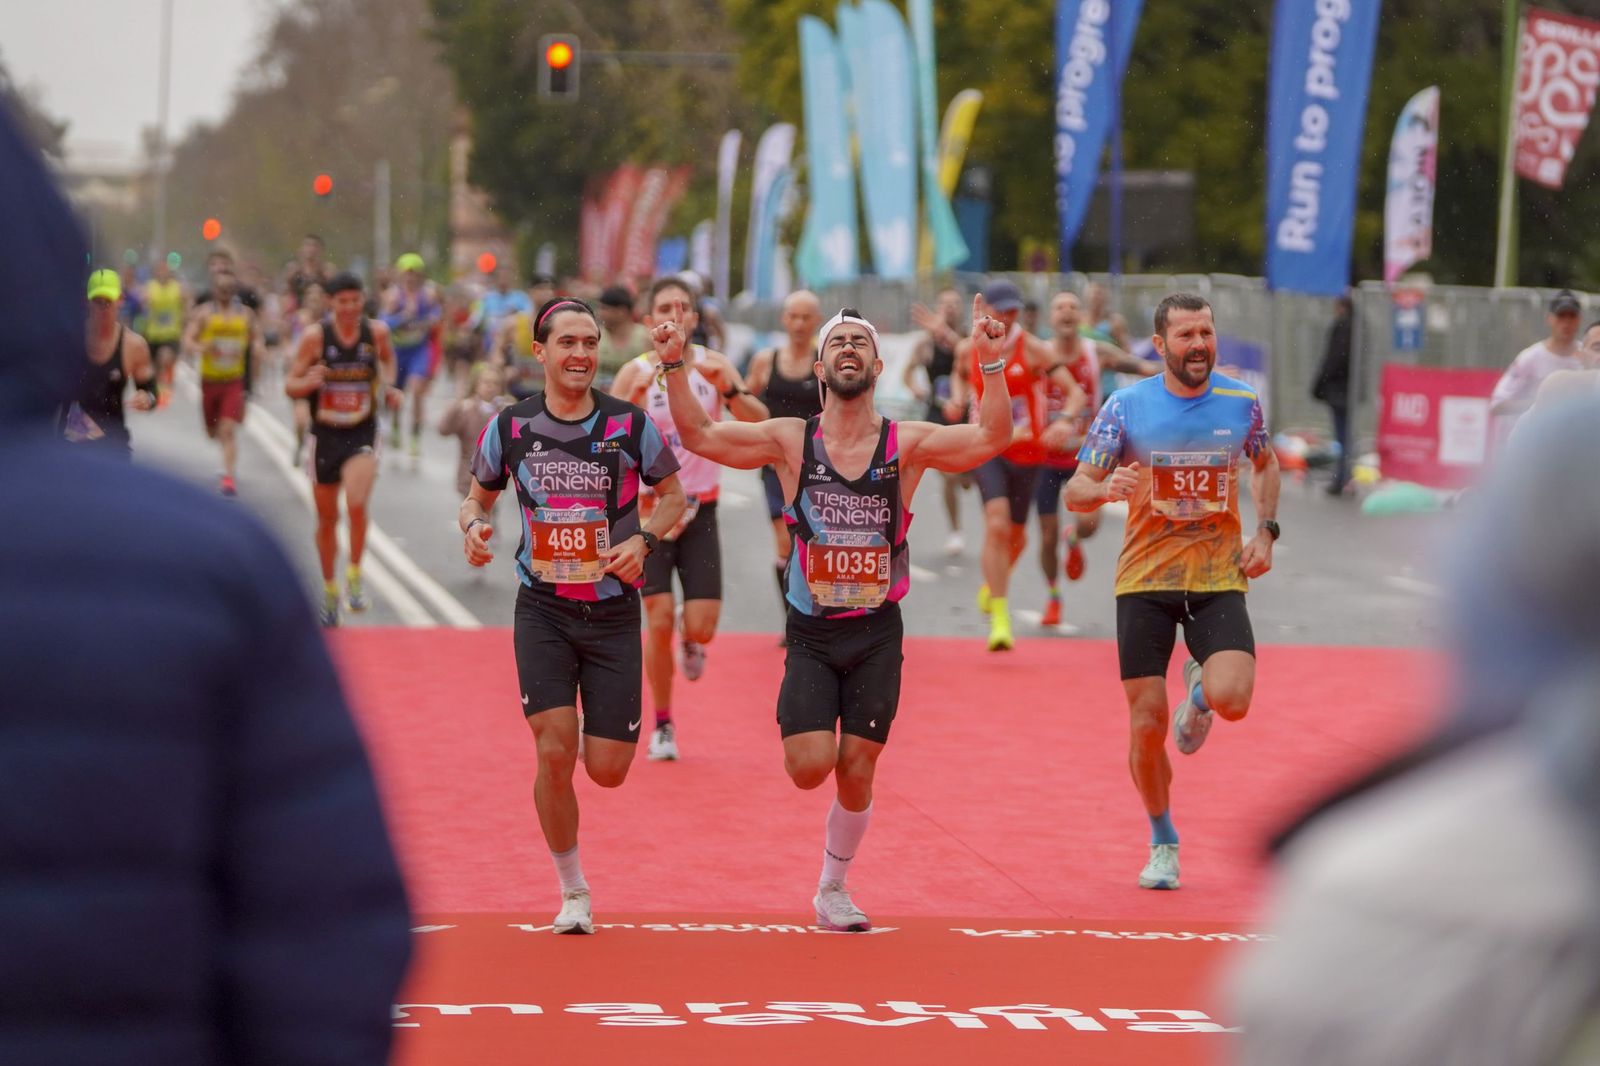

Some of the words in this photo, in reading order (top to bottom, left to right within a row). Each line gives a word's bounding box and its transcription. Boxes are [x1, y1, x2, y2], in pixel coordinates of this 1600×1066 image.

[1304, 0, 1352, 99] prog
[1291, 103, 1330, 153] to
[1275, 159, 1324, 254] Run
[808, 473, 832, 482] VIATOR
[1173, 470, 1210, 491] 512
[548, 528, 587, 551] 468
[823, 550, 877, 575] 1035
[392, 1001, 1212, 1020] maratón
